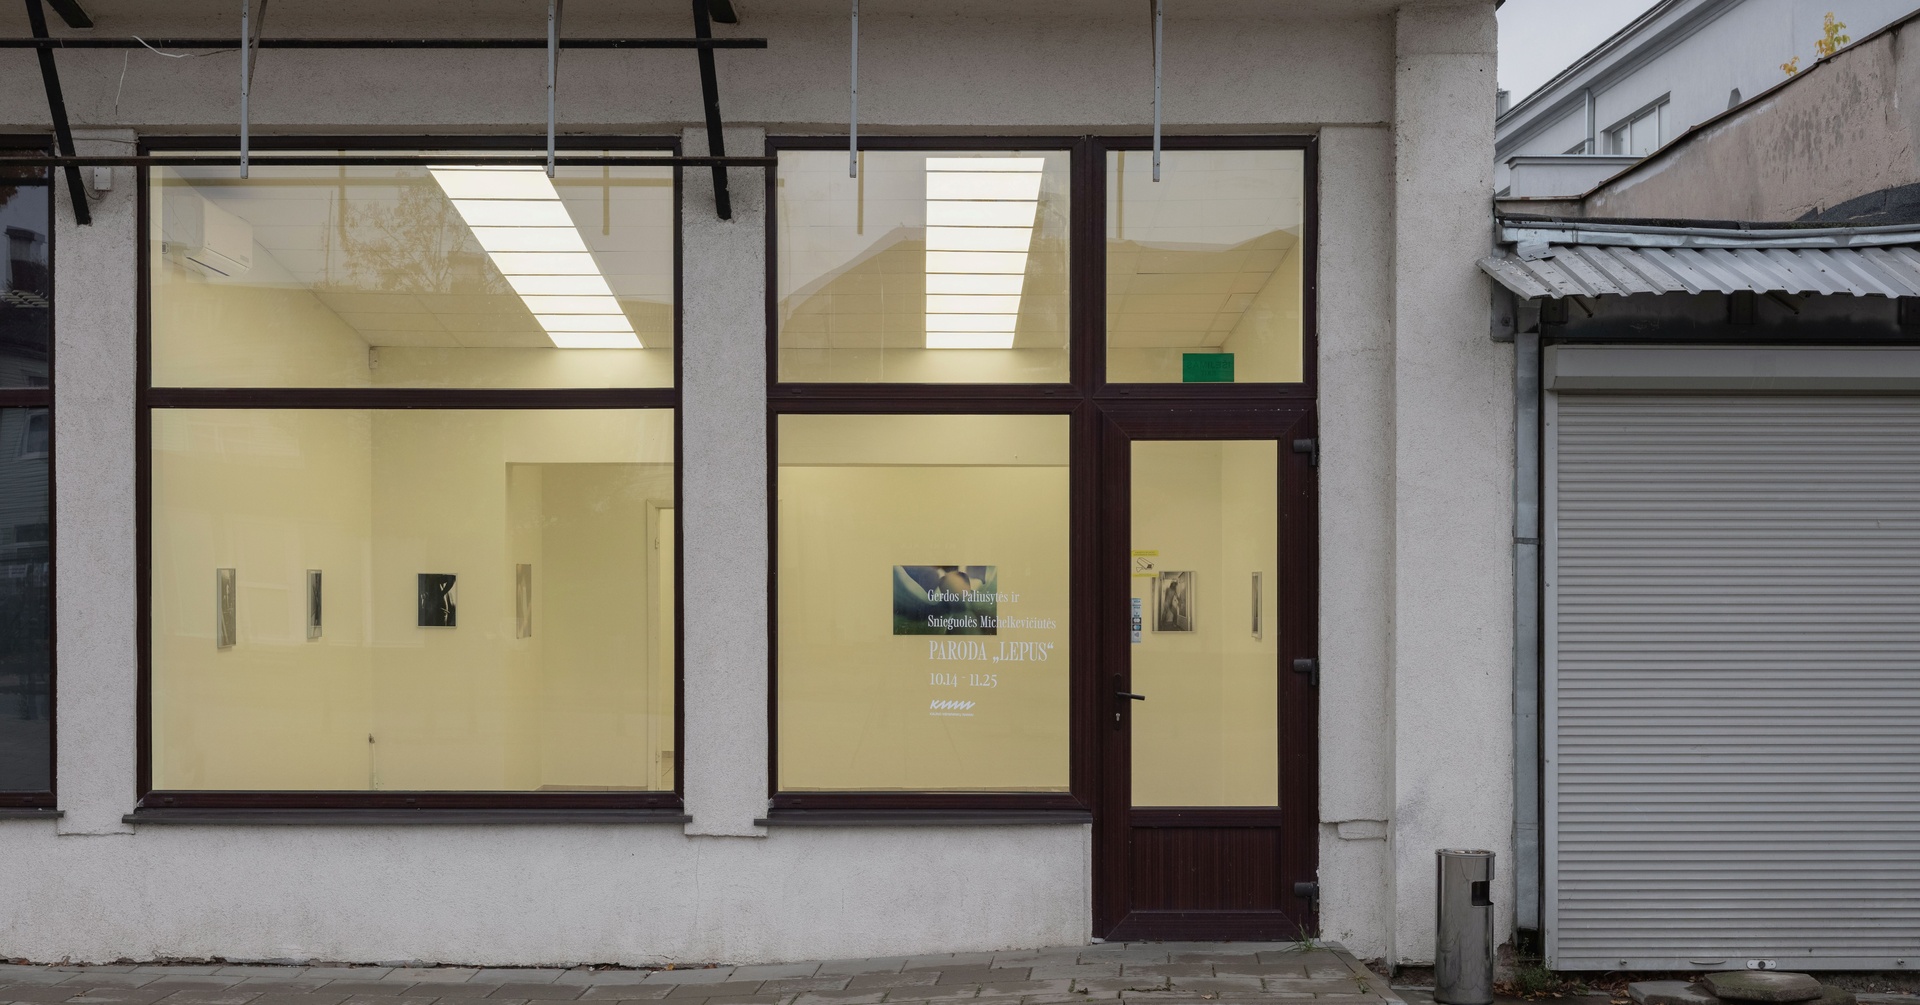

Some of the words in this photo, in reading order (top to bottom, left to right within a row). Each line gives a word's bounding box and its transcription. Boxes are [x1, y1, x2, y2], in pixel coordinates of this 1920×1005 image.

[928, 589, 959, 602] Gerdos
[962, 589, 1008, 605] Paliušytės
[1011, 591, 1020, 603] ir
[928, 615, 977, 630] Snieguolės
[929, 640, 987, 661] PARODA
[930, 673, 957, 687] 10.14
[970, 674, 998, 688] 11.25
